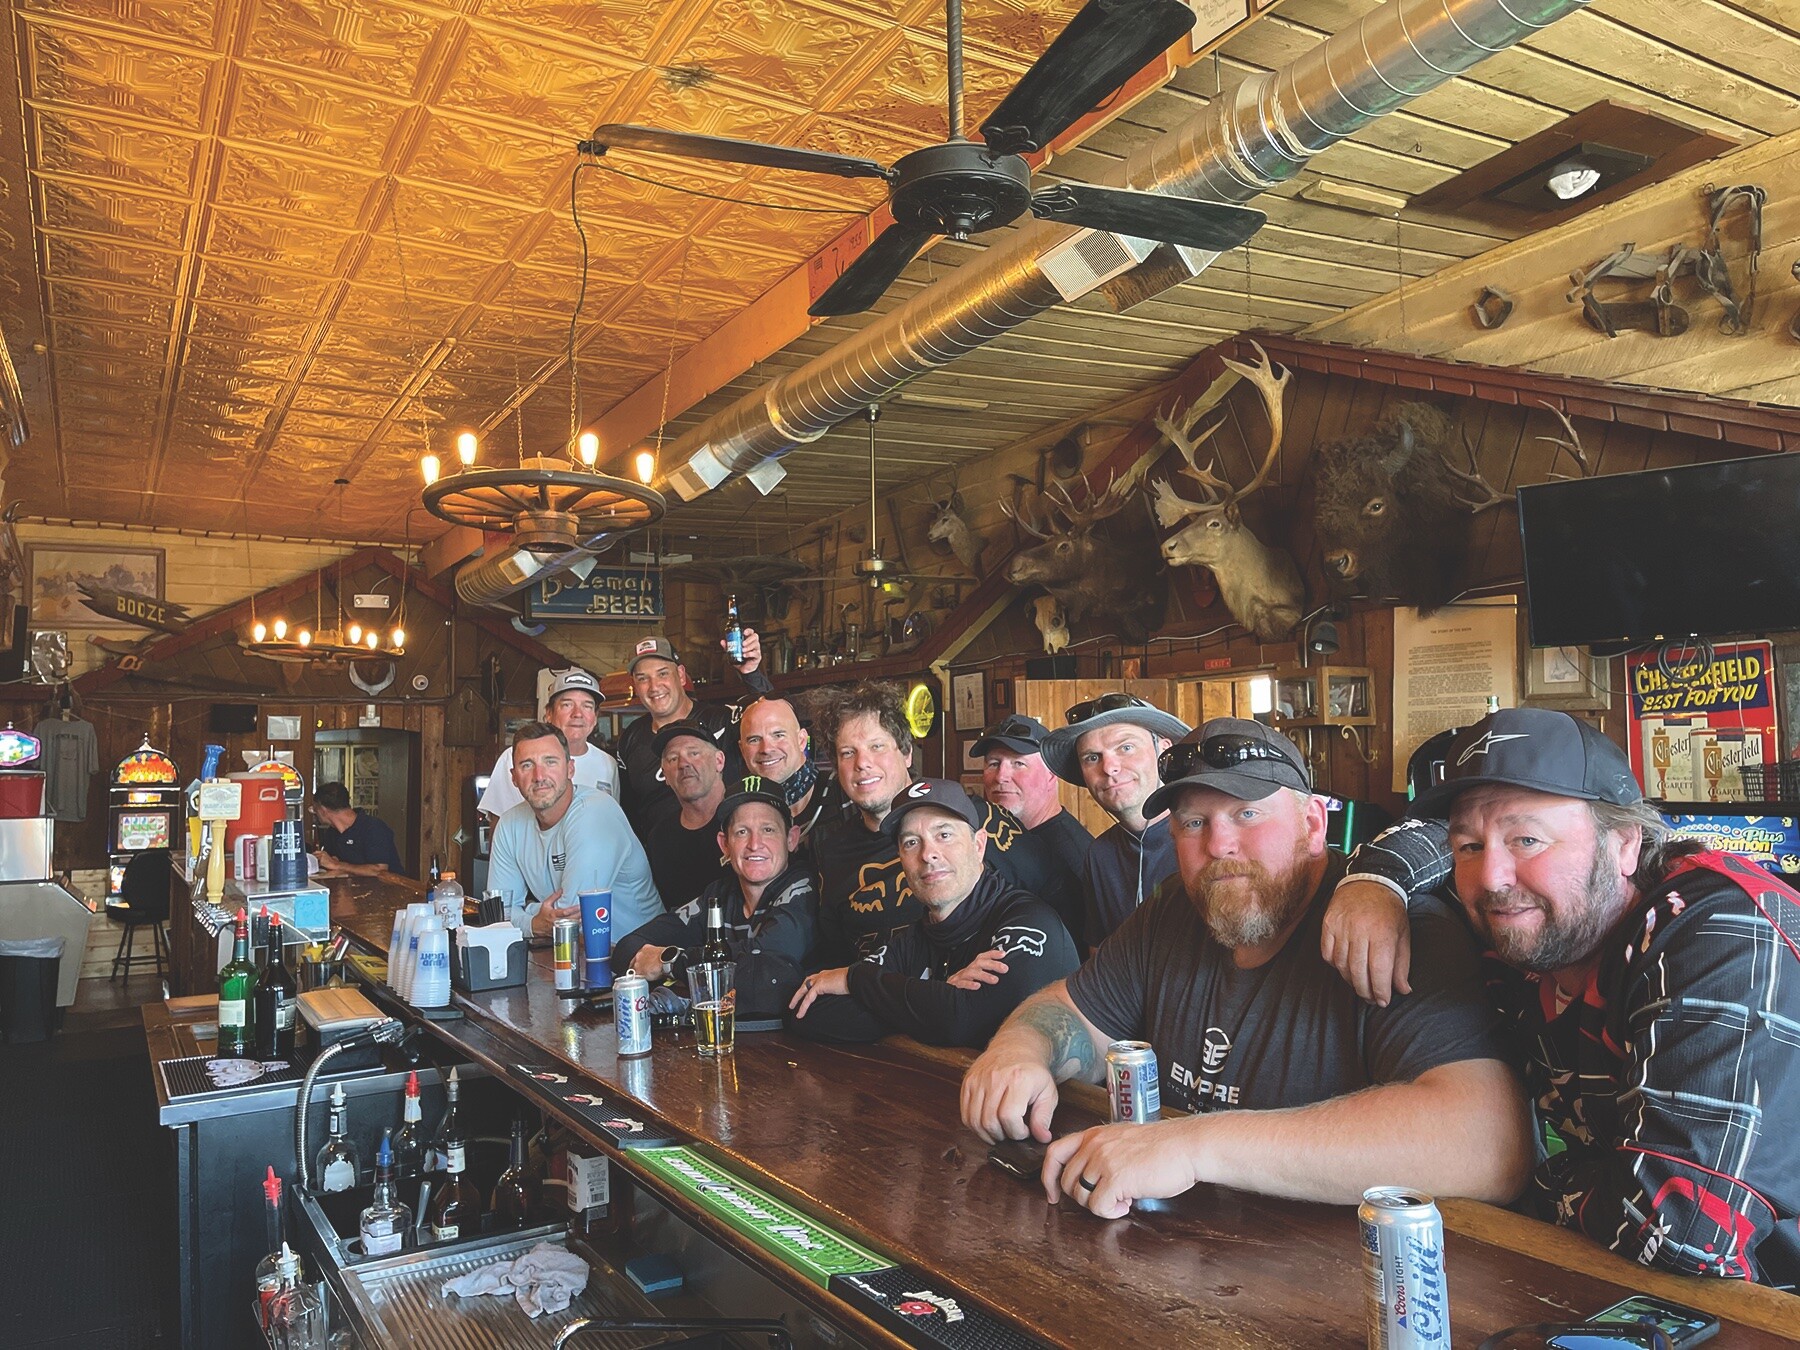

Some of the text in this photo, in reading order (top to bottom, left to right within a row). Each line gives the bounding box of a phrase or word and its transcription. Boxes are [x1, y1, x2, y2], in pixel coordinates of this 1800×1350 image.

[117, 596, 166, 624] BOOZE
[592, 594, 655, 615] BEER
[1641, 683, 1759, 711] BEST FOR YOU
[1712, 836, 1773, 852] Station
[1742, 828, 1784, 843] Plus
[592, 926, 610, 936] peps
[420, 952, 446, 960] LIGHT
[422, 959, 443, 967] BUD
[1119, 1069, 1133, 1122] GHTS
[1170, 1061, 1240, 1105] EMPRE
[1637, 1212, 1673, 1267] FOX
[1394, 1255, 1407, 1315] Coors LIGHT
[1406, 1235, 1443, 1342] Chill
